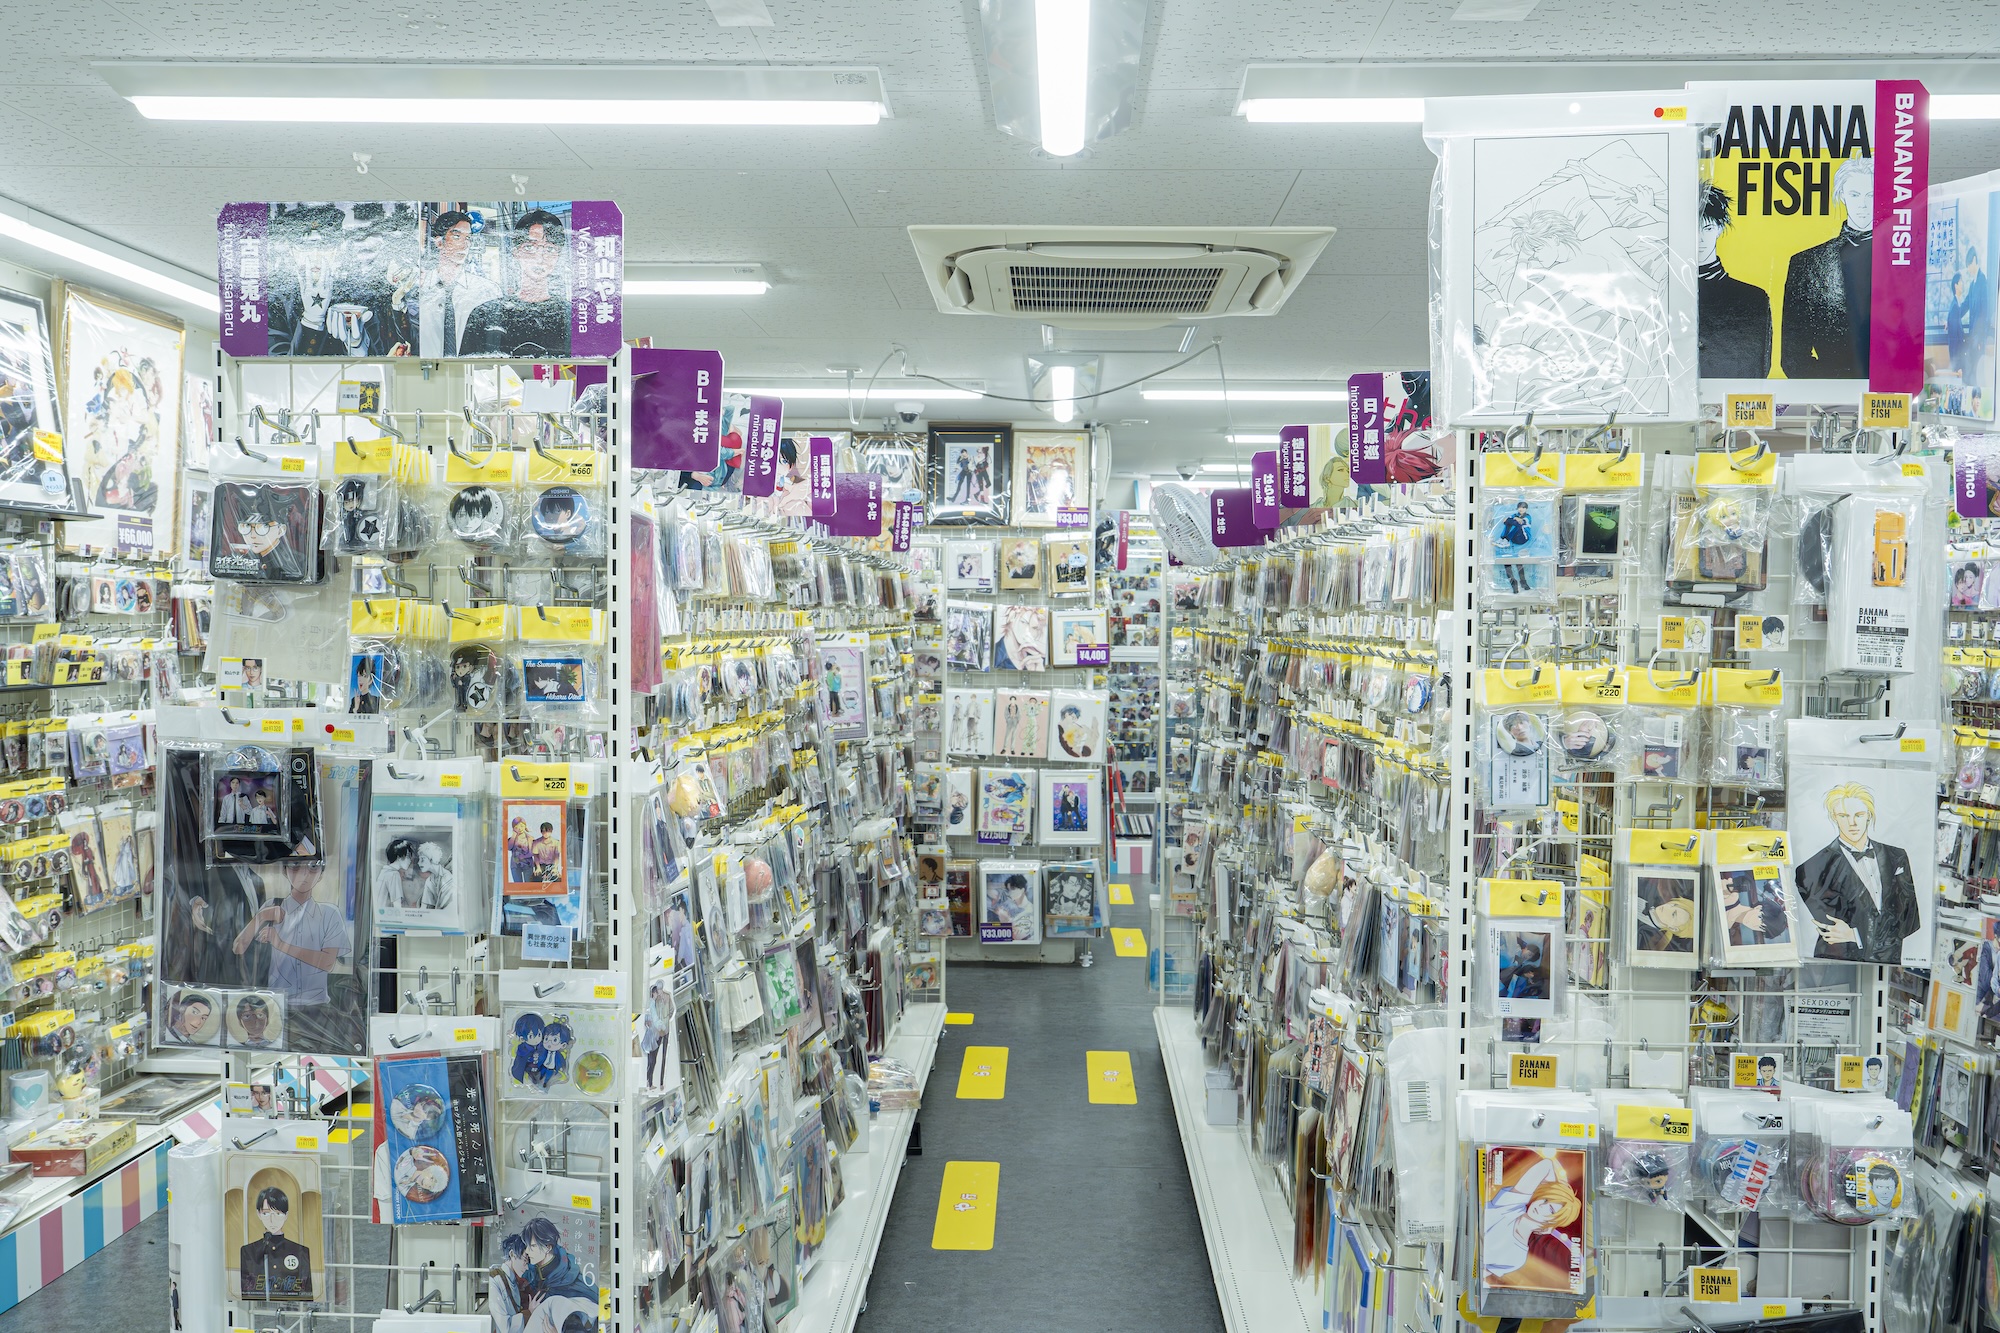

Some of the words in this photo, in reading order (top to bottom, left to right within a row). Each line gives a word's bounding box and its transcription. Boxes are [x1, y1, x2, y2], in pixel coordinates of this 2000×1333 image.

[1713, 105, 1871, 158] ANANA
[1893, 92, 1915, 204] BANANA
[1737, 161, 1830, 216] FISH
[1893, 208, 1914, 266] FISH
[577, 226, 590, 290] Wayama
[239, 236, 262, 323] 古屋兎丸
[594, 236, 616, 324] 和山やま
[224, 271, 235, 337] usamaru
[577, 293, 590, 334] Yama
[697, 370, 710, 405] BL
[1350, 385, 1360, 430] hinohara
[1735, 401, 1767, 411] BANANA
[1735, 411, 1755, 420] FISH
[1870, 399, 1903, 410] BANANA
[1870, 409, 1891, 419] FISH
[692, 409, 709, 444] ま行
[751, 414, 761, 461] minaduki
[1363, 397, 1380, 460] 日ノ原巡
[759, 417, 778, 477] 南月ゆう
[1281, 440, 1290, 467] higuchi
[1350, 431, 1360, 472] meguru
[571, 467, 591, 475] ¥660
[748, 462, 757, 477] yuu
[812, 455, 820, 487] momose
[1965, 453, 1979, 498] Arinco
[868, 481, 877, 498] BL
[1254, 476, 1262, 504] harada
[1263, 473, 1276, 507] はらだ
[1282, 468, 1290, 494] misao
[867, 501, 878, 521] や行
[1216, 498, 1225, 515] BL
[1057, 513, 1088, 524] ¥33,000
[1216, 517, 1227, 535] は行
[118, 527, 153, 547] ¥66,000
[1858, 607, 1888, 617] BANANA
[1858, 616, 1877, 625] FISH
[1077, 649, 1107, 662] ¥4,400
[545, 693, 567, 701] Hikaru
[1598, 688, 1619, 697] ¥220
[545, 781, 566, 789] ¥220
[979, 831, 1008, 840] ¥27,500
[527, 933, 567, 943] 異世界の沙汰
[981, 929, 1012, 939] ¥33,000
[1801, 998, 1818, 1006] SEX
[1819, 999, 1842, 1007] DROP
[1519, 1059, 1550, 1070] BANANA
[1519, 1068, 1538, 1079] FISH
[465, 1087, 487, 1184] 光が死んだ夏
[1664, 1126, 1688, 1134] ¥330
[1739, 1159, 1769, 1209] HAVE
[1856, 1166, 1867, 1207] BANANA
[574, 1218, 583, 1265] の沙汰は
[587, 1219, 596, 1255] 異世界
[287, 1258, 297, 1268] 15
[582, 1262, 596, 1287] 6
[1700, 1275, 1732, 1286] BANANA
[1700, 1284, 1720, 1295] FISH
